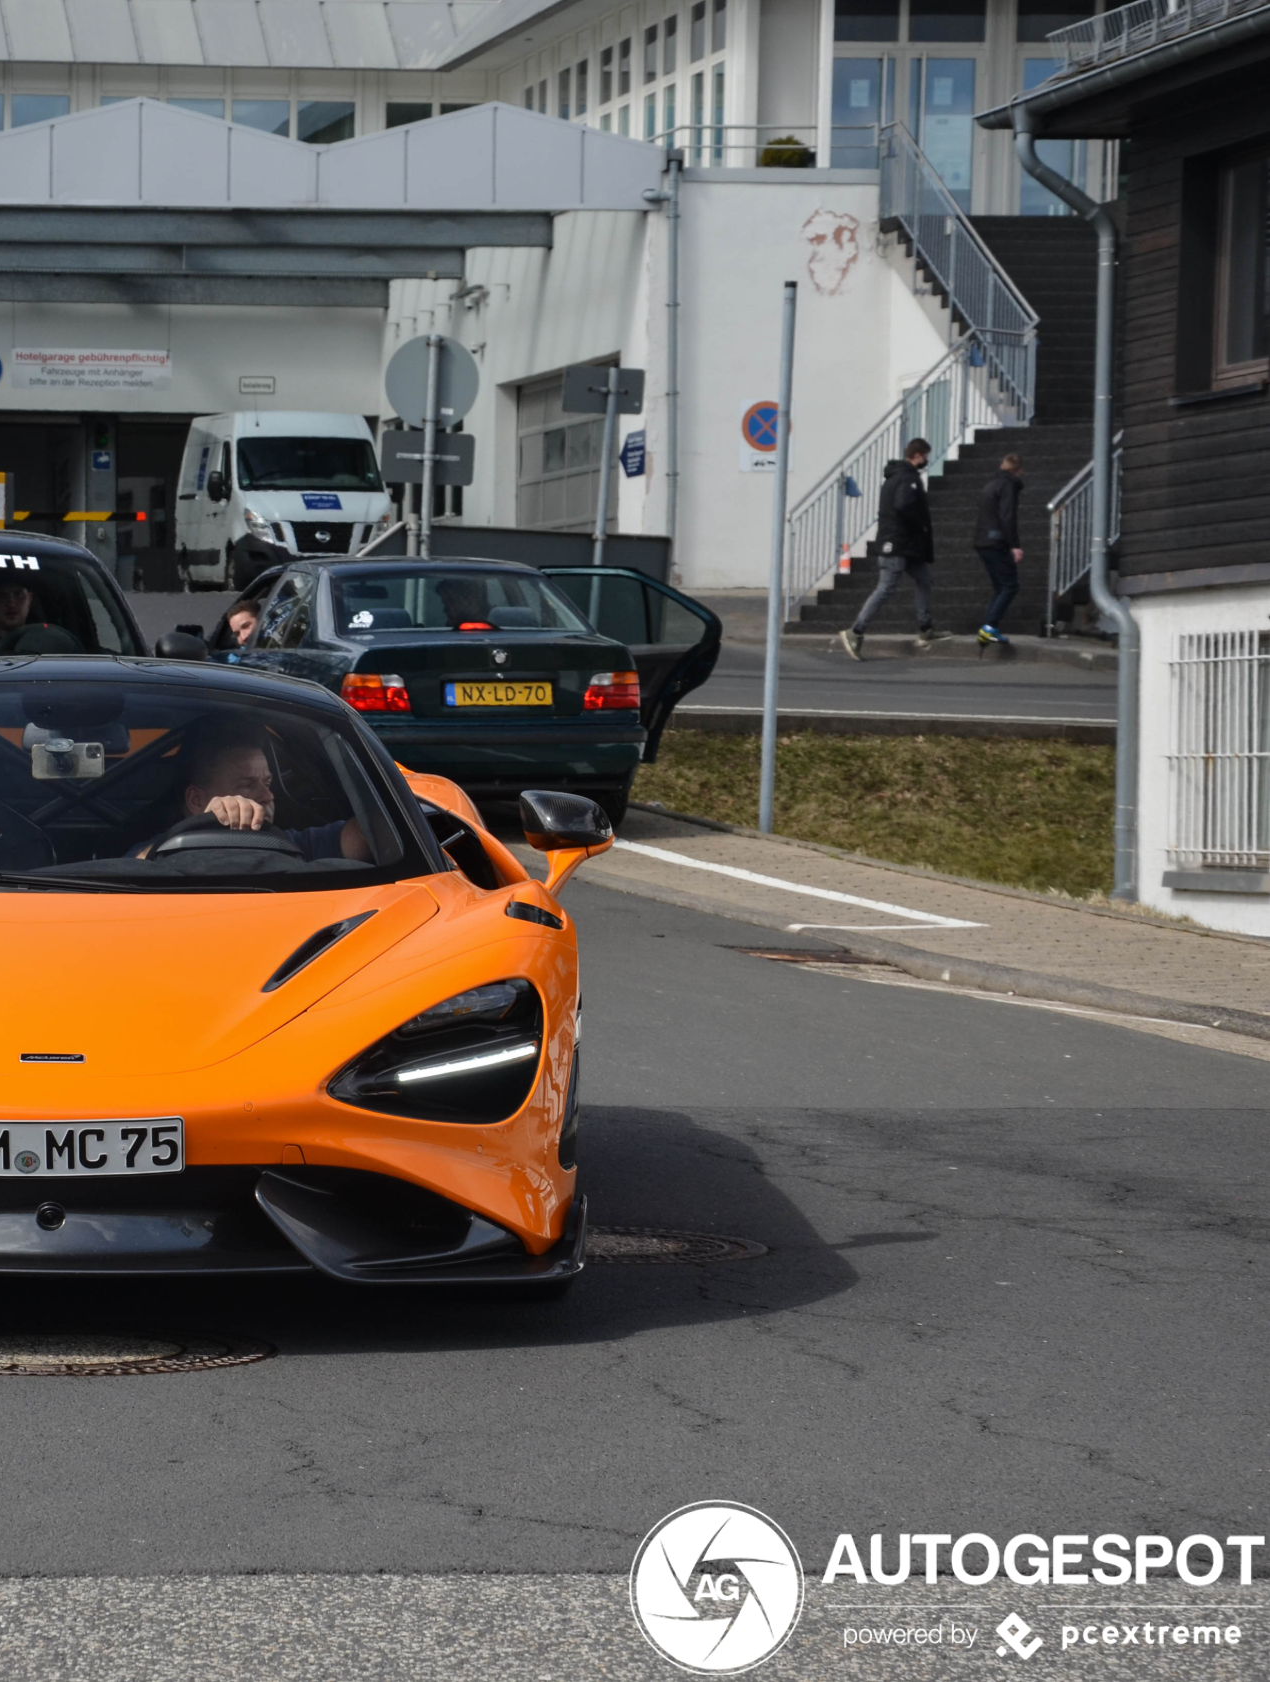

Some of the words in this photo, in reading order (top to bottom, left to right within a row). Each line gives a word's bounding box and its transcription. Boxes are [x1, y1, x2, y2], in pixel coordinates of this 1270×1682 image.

[15, 352, 75, 363] Hotelgarage
[41, 367, 86, 377] Fahrzeuge
[88, 367, 101, 376] mit
[103, 367, 144, 378] Anhänger
[29, 378, 48, 386] bitte
[79, 379, 120, 388] Rezeption
[462, 685, 546, 702] NX-LD-70
[45, 1128, 108, 1169] MC
[120, 1126, 179, 1168] 75
